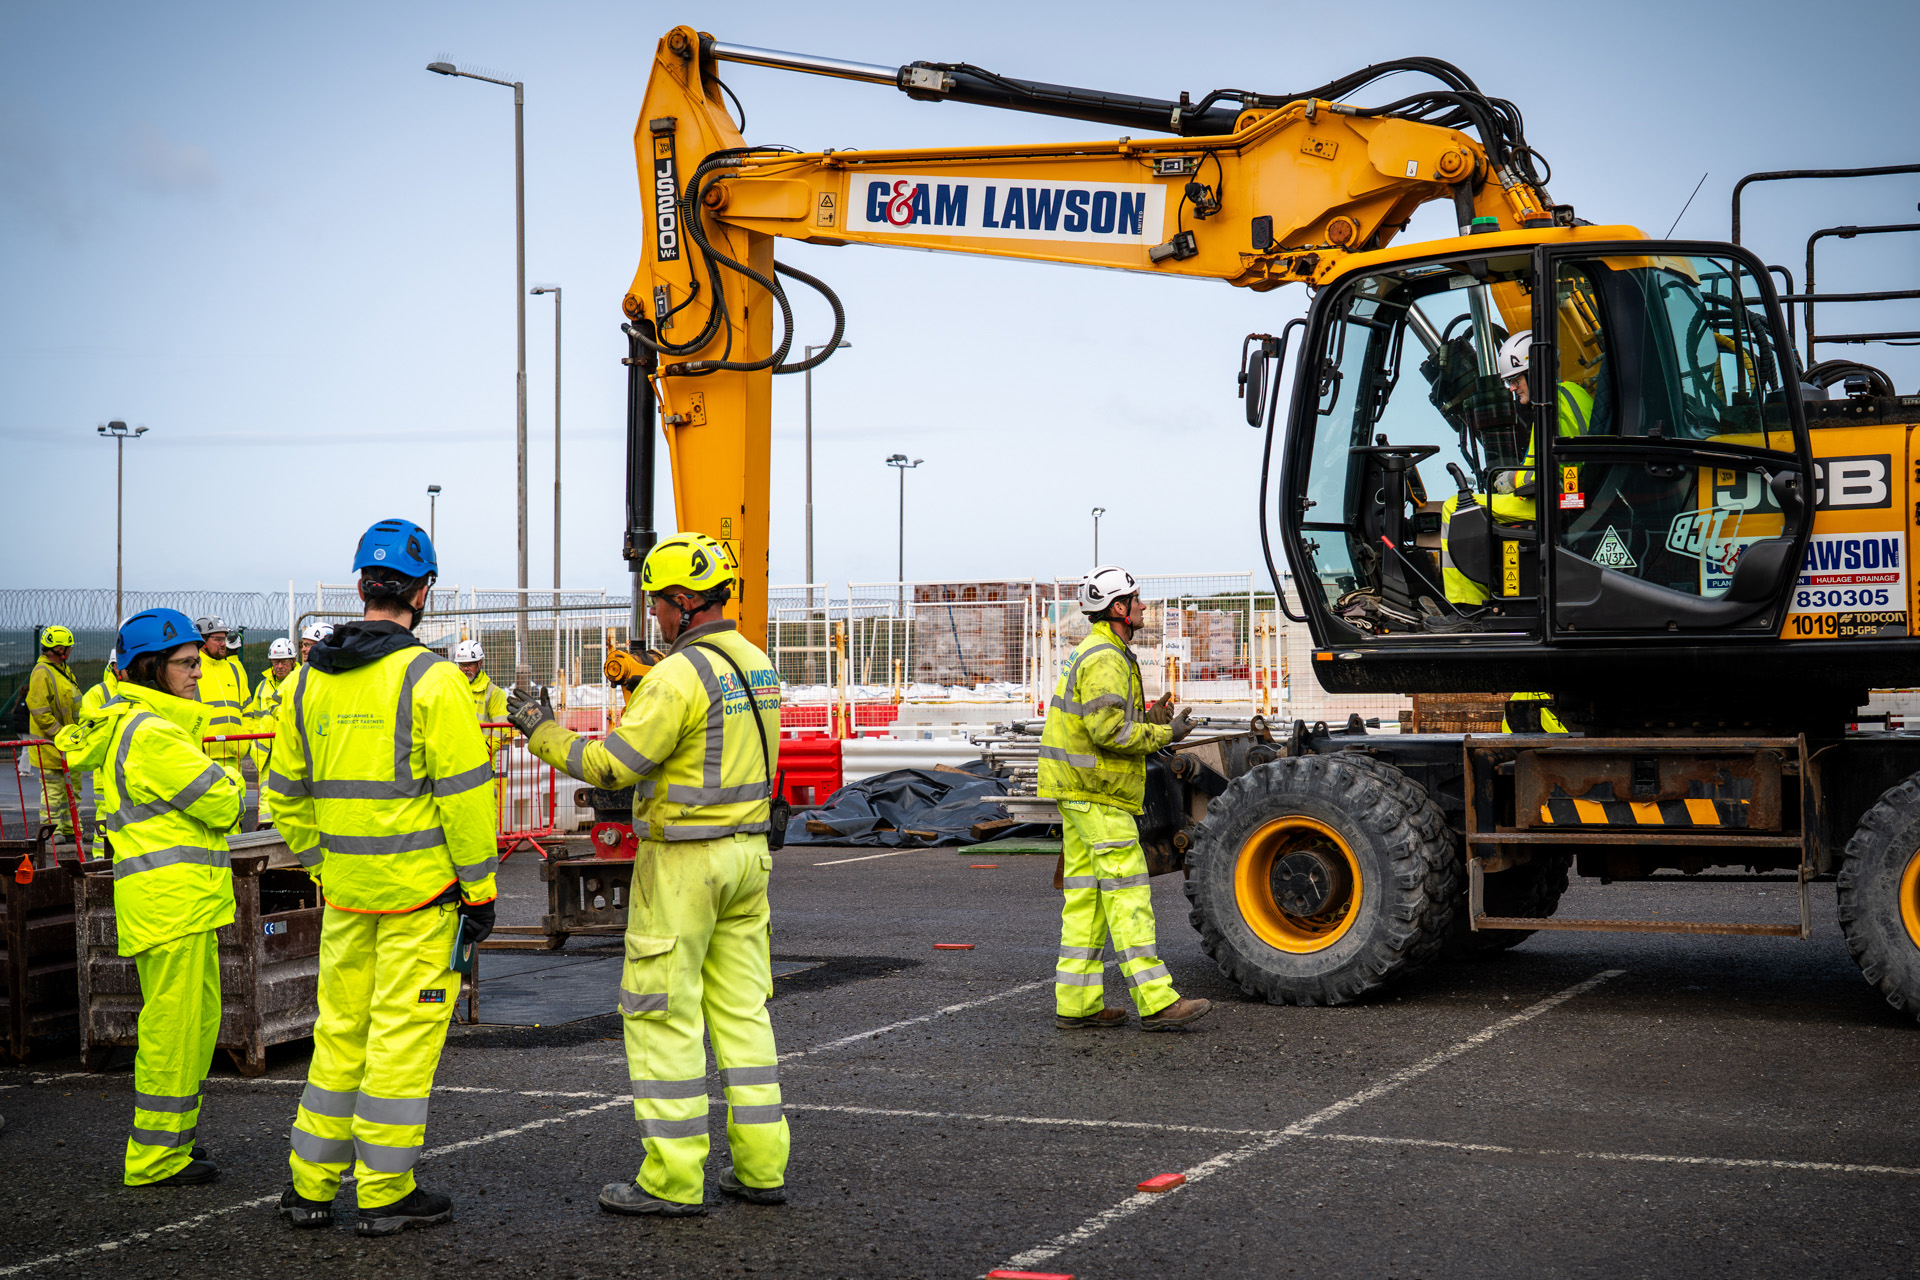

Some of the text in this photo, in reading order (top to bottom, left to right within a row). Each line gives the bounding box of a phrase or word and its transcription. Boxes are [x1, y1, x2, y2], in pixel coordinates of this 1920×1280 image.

[657, 160, 676, 248] JS200
[866, 178, 1146, 235] G&AM LAWSON
[1136, 210, 1145, 236] LIMITED
[660, 249, 677, 258] W+
[1605, 542, 1618, 553] 57
[1801, 537, 1900, 571] AWSON
[1816, 574, 1896, 584] HAULAGE DRAINAGE
[1796, 588, 1890, 608] 830305
[1791, 614, 1837, 636] 1019
[1856, 612, 1905, 623] TOPCON
[1840, 625, 1878, 636] 3D-GPS
[745, 669, 779, 687] LAWSO
[725, 698, 781, 716] 01946 3030
